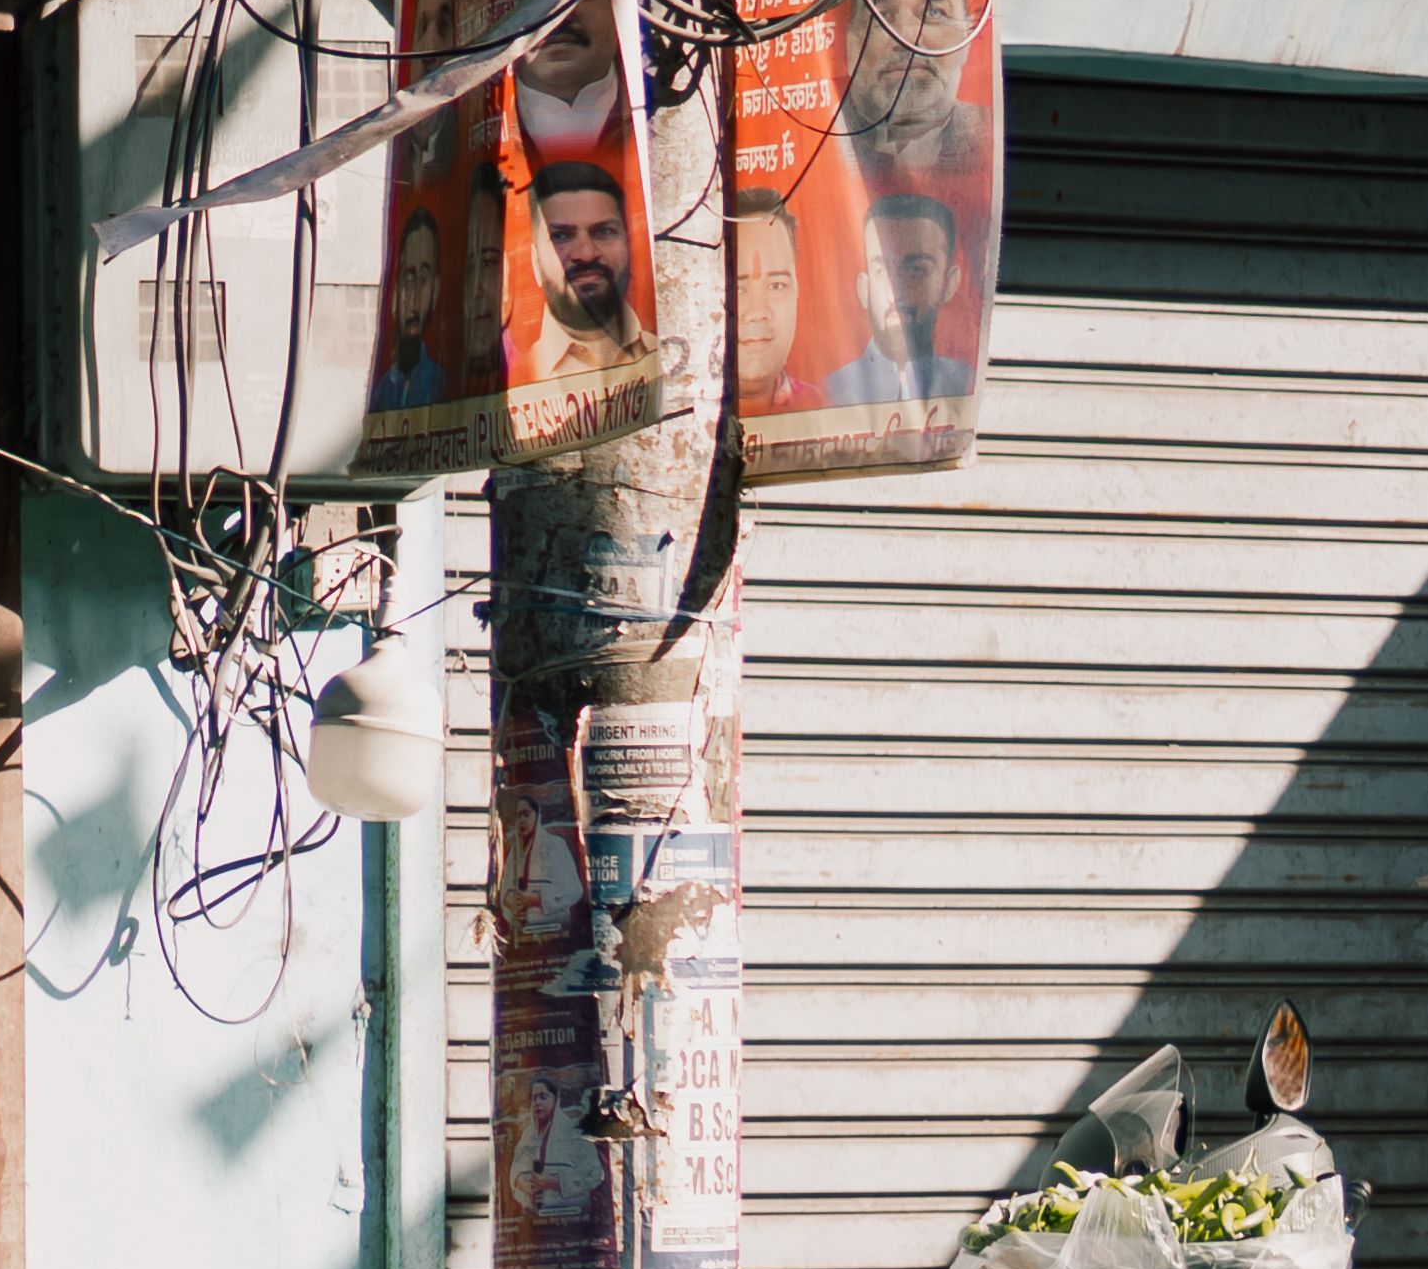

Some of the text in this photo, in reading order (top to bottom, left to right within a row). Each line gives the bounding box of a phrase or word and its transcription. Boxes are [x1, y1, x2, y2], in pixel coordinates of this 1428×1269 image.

[525, 399, 598, 460] FASHION
[589, 724, 677, 741] URGENT HIRING
[594, 750, 624, 761] WORK
[626, 749, 655, 760] FROM
[588, 765, 616, 776] WORK
[617, 764, 644, 775] DAILY
[653, 764, 664, 774] TO
[585, 856, 619, 868] ANCE
[587, 870, 619, 883] ATION
